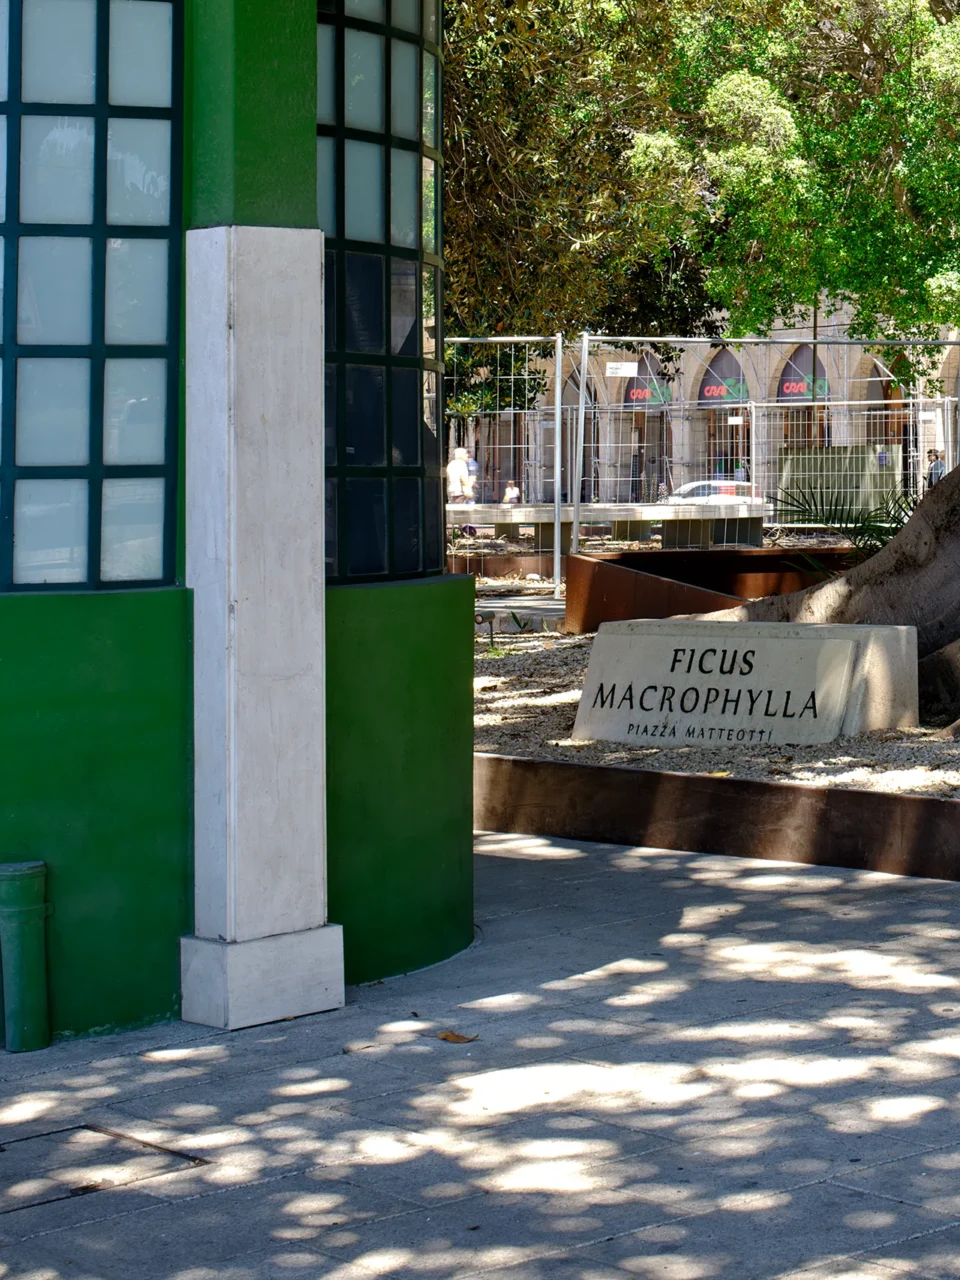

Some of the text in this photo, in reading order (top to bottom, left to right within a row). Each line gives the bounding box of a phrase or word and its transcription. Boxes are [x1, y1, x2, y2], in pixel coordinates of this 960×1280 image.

[670, 648, 756, 676] FICUS
[592, 683, 819, 719] MACROPHYLLA
[627, 723, 773, 742] PIAZZA MATTEOTTI
